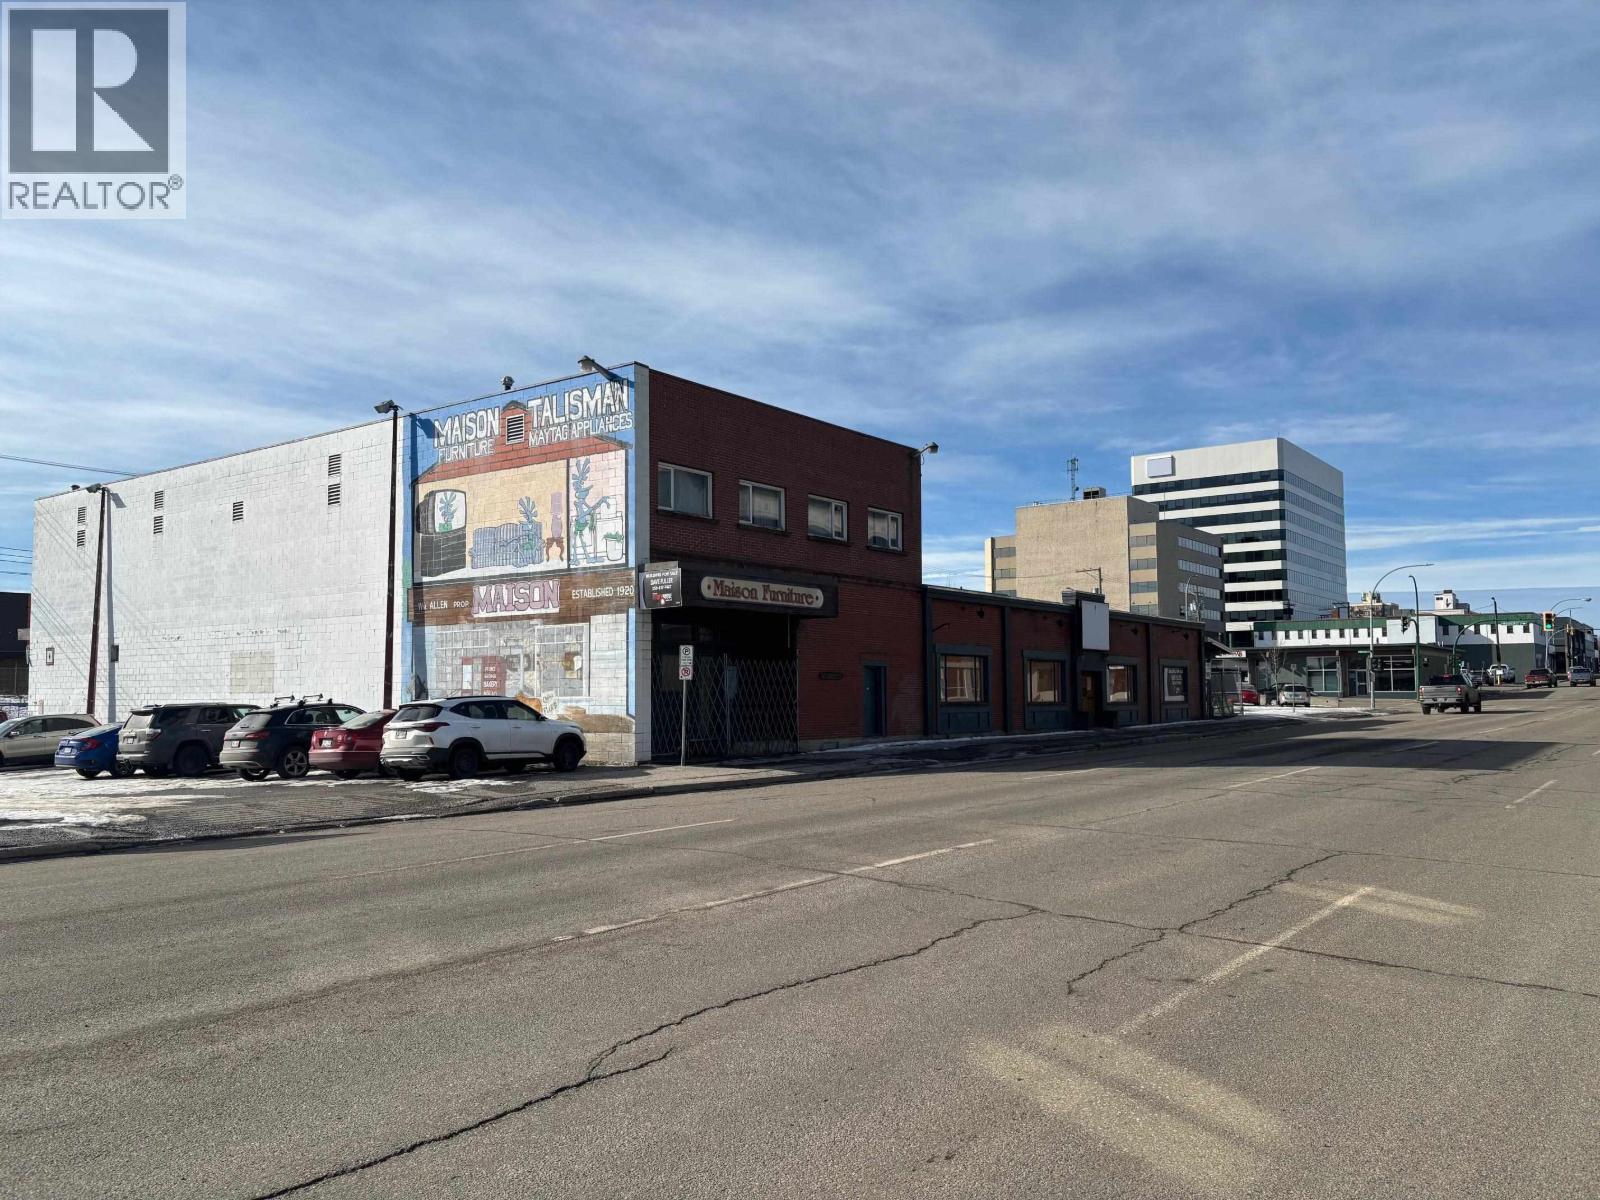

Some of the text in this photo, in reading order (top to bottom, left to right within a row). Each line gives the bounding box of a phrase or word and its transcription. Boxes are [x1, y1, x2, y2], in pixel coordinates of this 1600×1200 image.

[527, 378, 629, 430] TALISMAN
[433, 406, 501, 449] MAISON
[528, 411, 633, 448] MAYTAG APPLIANCES
[438, 439, 496, 463] FURNITURE
[429, 600, 448, 610] ALLEN
[471, 578, 561, 615] MAISON
[571, 584, 635, 600] ESTABLISHED 1920
[712, 578, 814, 604] Maison Furniture
